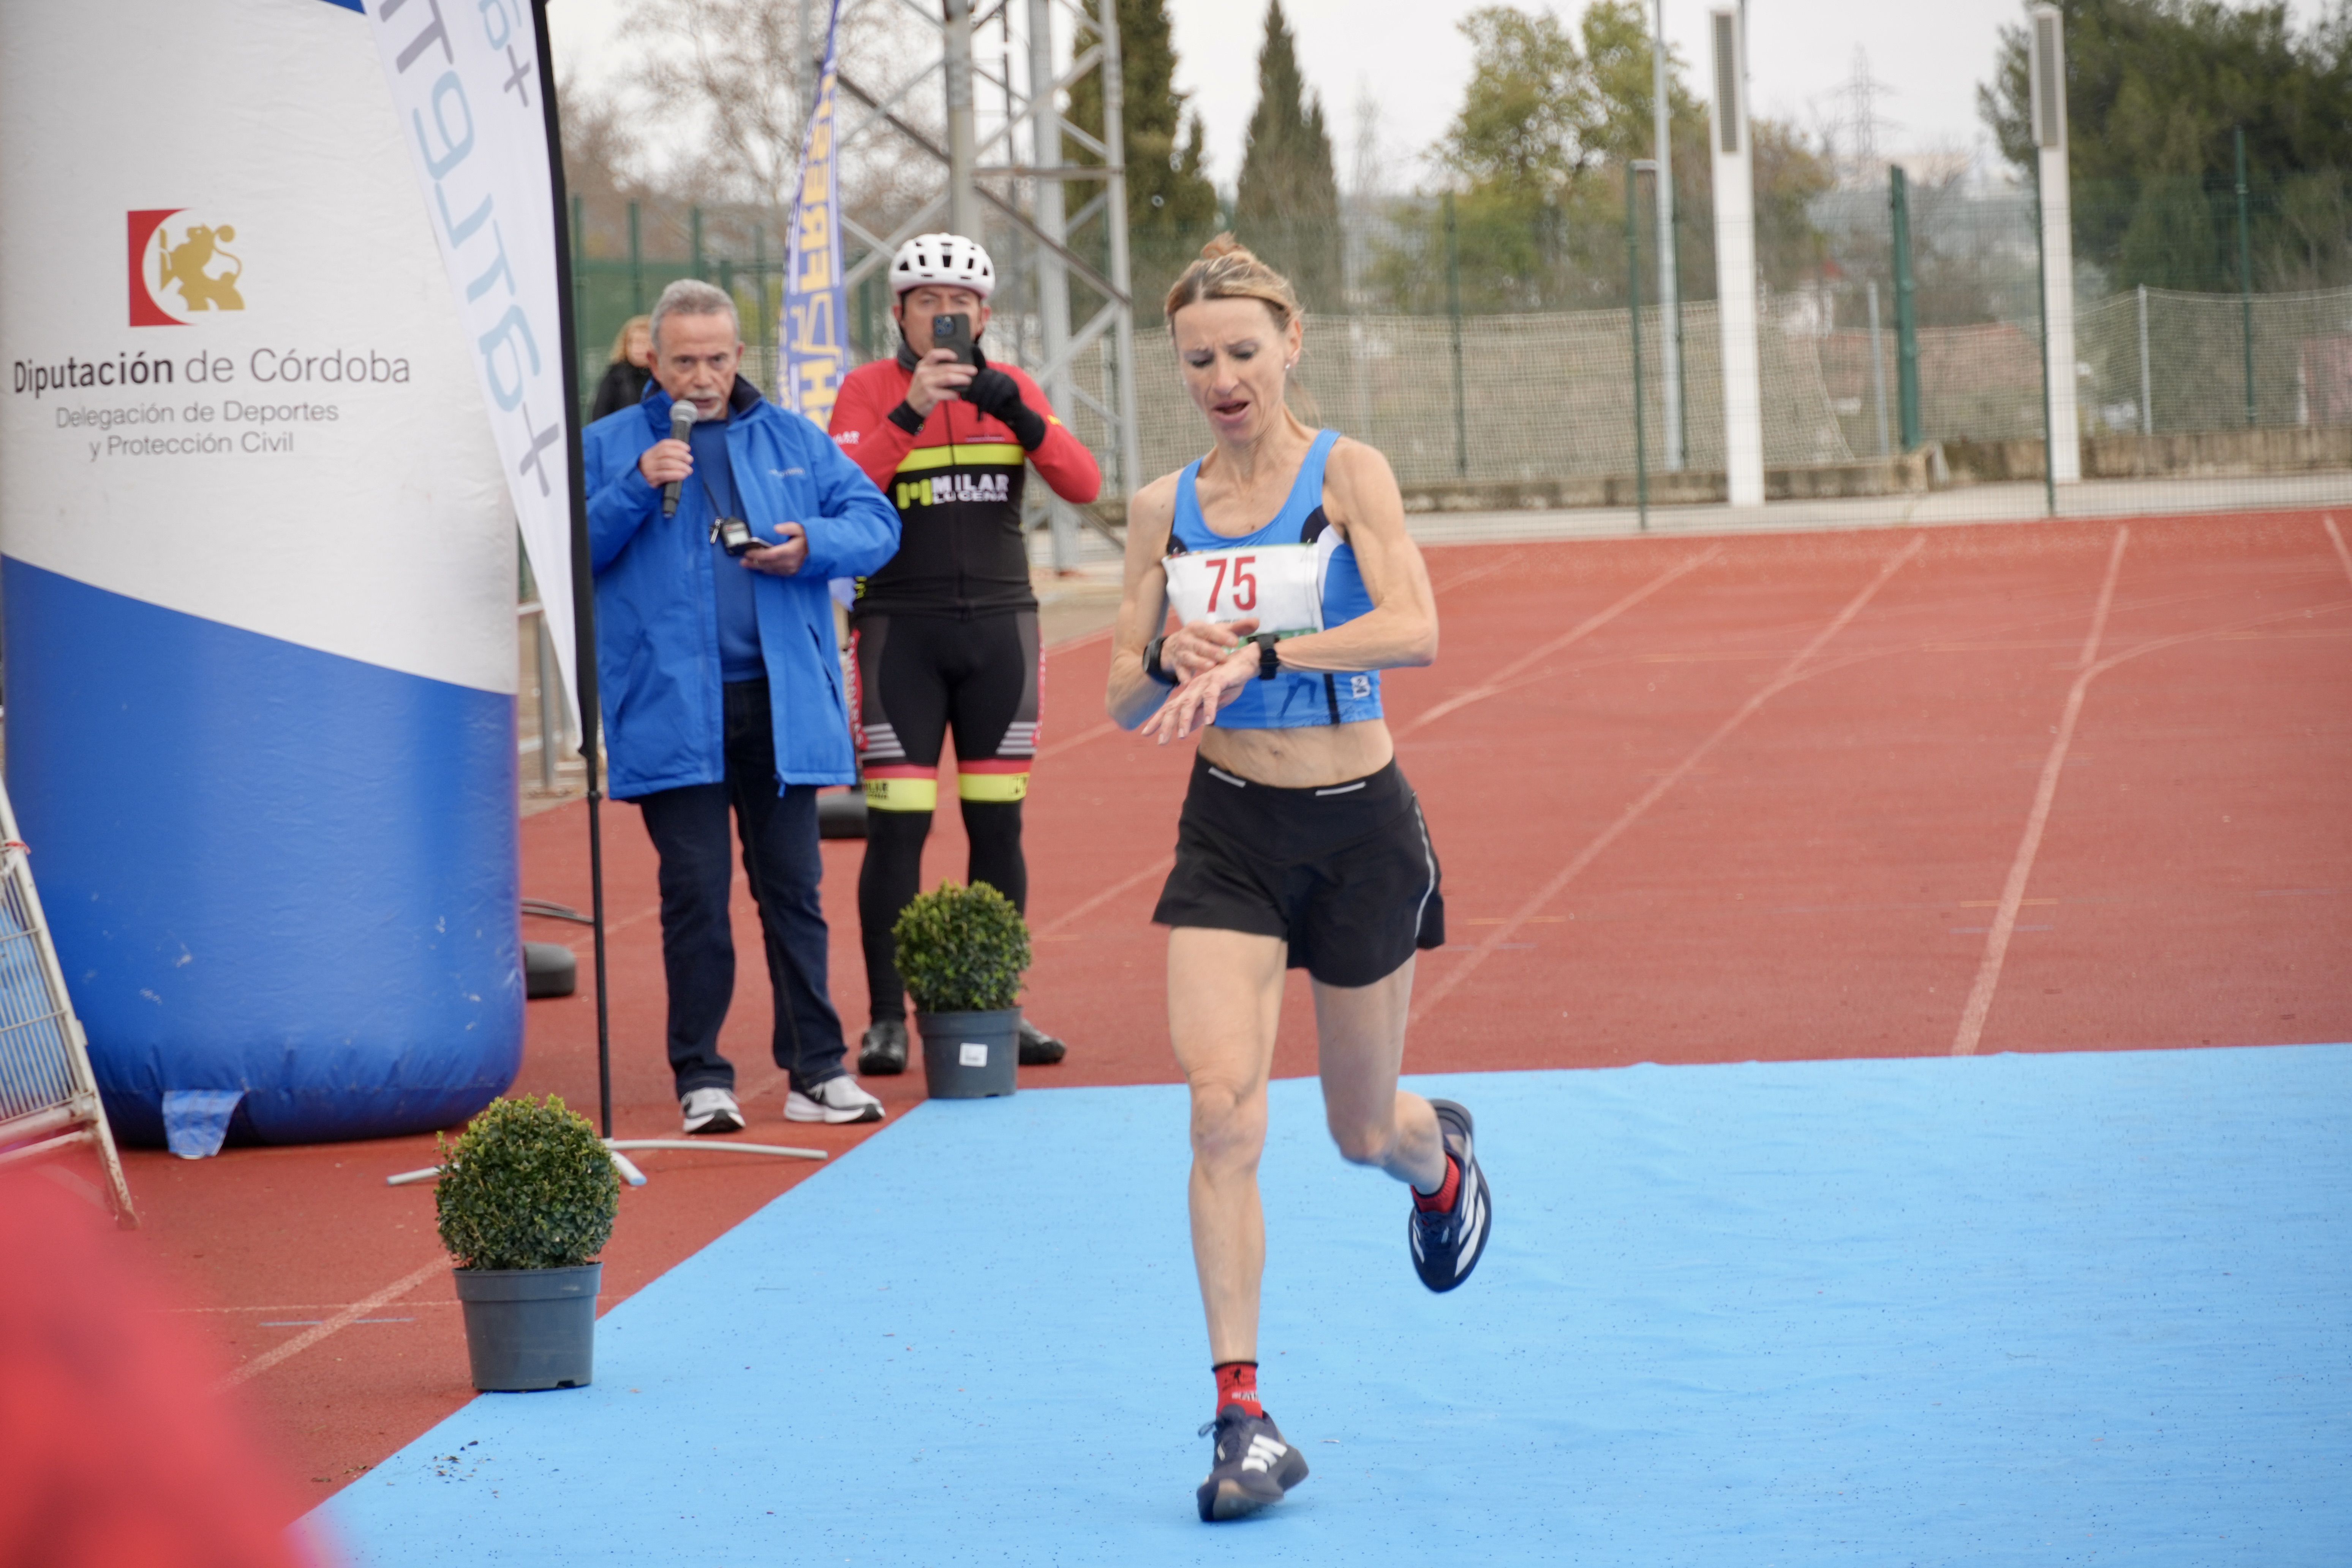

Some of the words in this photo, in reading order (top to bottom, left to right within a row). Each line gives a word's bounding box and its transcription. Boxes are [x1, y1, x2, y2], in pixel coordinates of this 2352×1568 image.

[14, 351, 174, 399] Diputación
[185, 349, 234, 383] de
[250, 348, 410, 383] Córdoba
[56, 403, 174, 431] Delegación
[183, 401, 215, 423] de
[223, 400, 339, 425] Deportes
[89, 441, 101, 462] y
[107, 432, 232, 455] Protección
[241, 431, 294, 453] Civil
[931, 474, 1009, 493] MILAR
[933, 490, 1008, 504] LUCENA
[1205, 555, 1257, 613] 75
